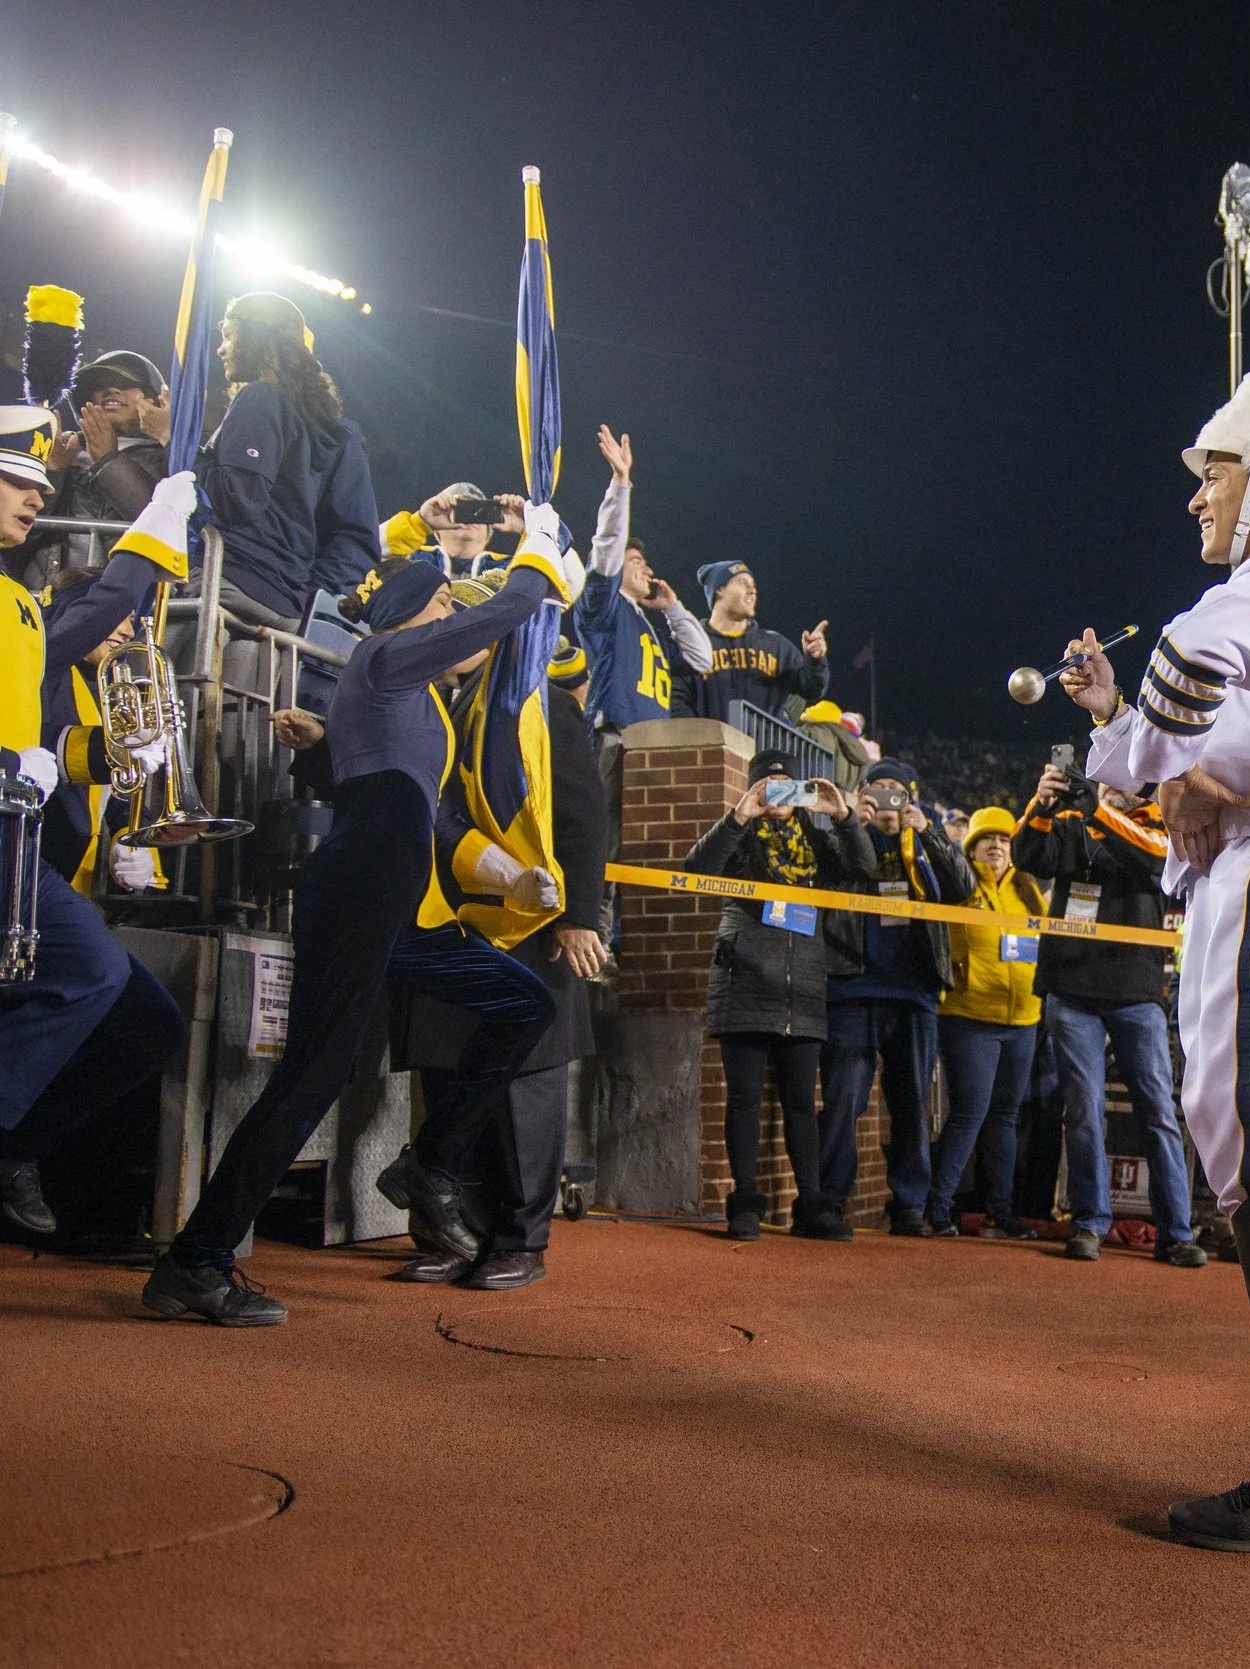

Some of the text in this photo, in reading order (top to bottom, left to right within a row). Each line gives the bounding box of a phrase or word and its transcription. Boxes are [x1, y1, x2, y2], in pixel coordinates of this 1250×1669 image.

[30, 430, 51, 461] M
[670, 875, 756, 896] M MICHIGAN
[1027, 918, 1097, 936] M MICHIGAN
